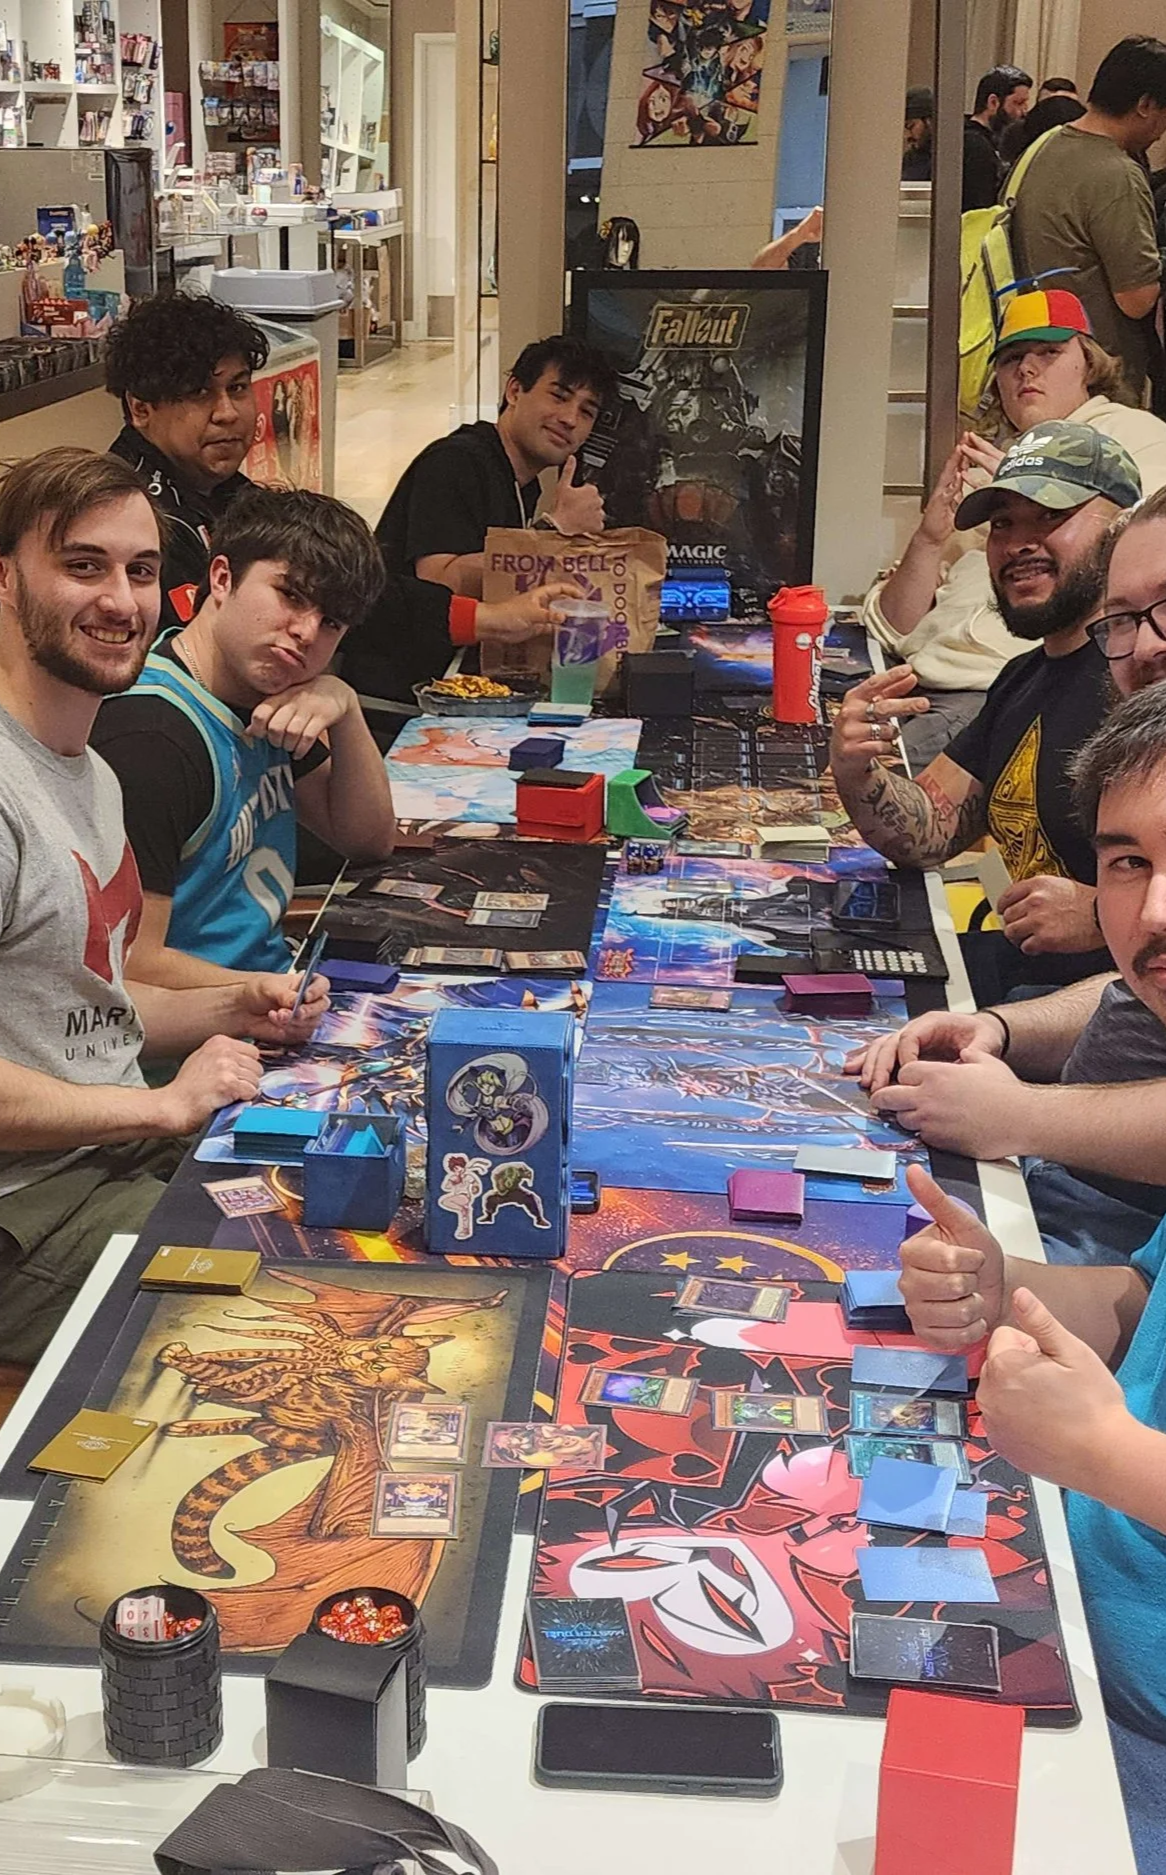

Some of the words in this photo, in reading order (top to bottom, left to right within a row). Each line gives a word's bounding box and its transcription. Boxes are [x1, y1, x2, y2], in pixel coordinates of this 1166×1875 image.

[651, 310, 739, 344] Fallout
[999, 455, 1044, 476] adidas
[667, 544, 727, 559] MAGIC
[492, 554, 555, 572] FROM
[563, 554, 610, 573] BELL
[613, 554, 627, 577] TO
